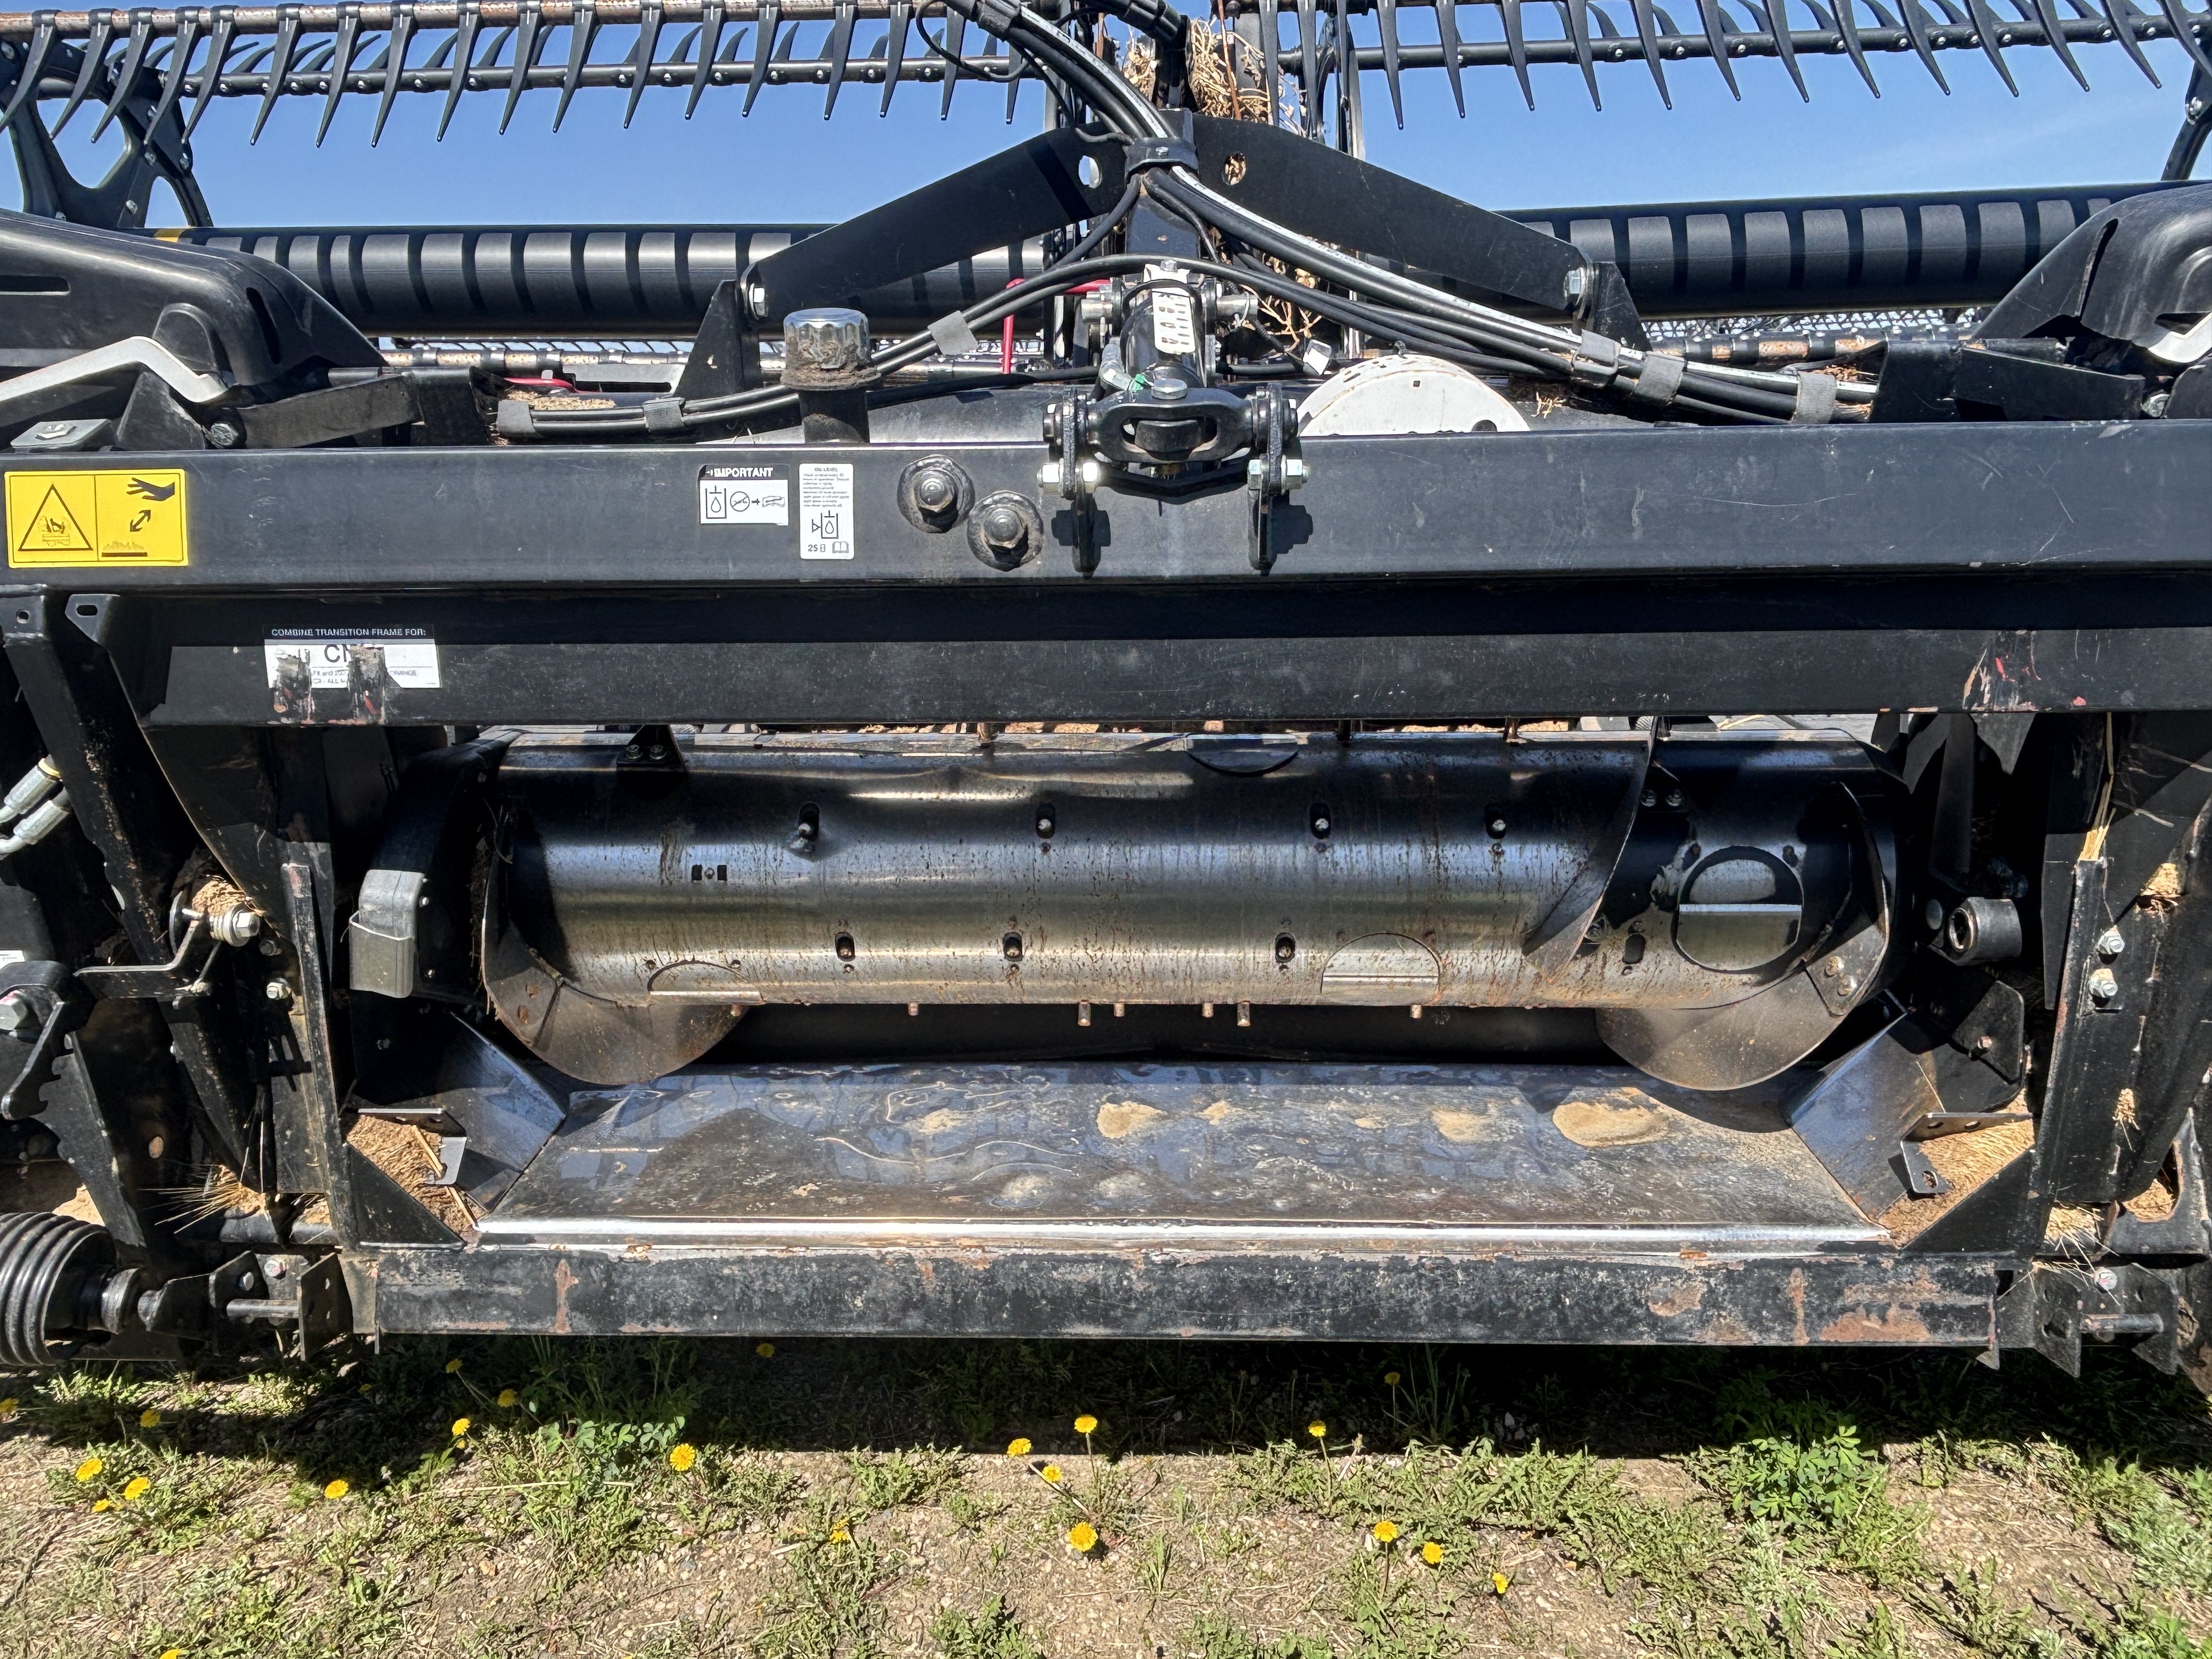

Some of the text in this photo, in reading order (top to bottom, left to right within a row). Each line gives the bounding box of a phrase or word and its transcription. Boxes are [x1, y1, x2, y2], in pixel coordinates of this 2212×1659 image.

[714, 467, 774, 478] IMPORTANT
[271, 628, 314, 636] COMBINE
[315, 628, 370, 636] TRANSITION
